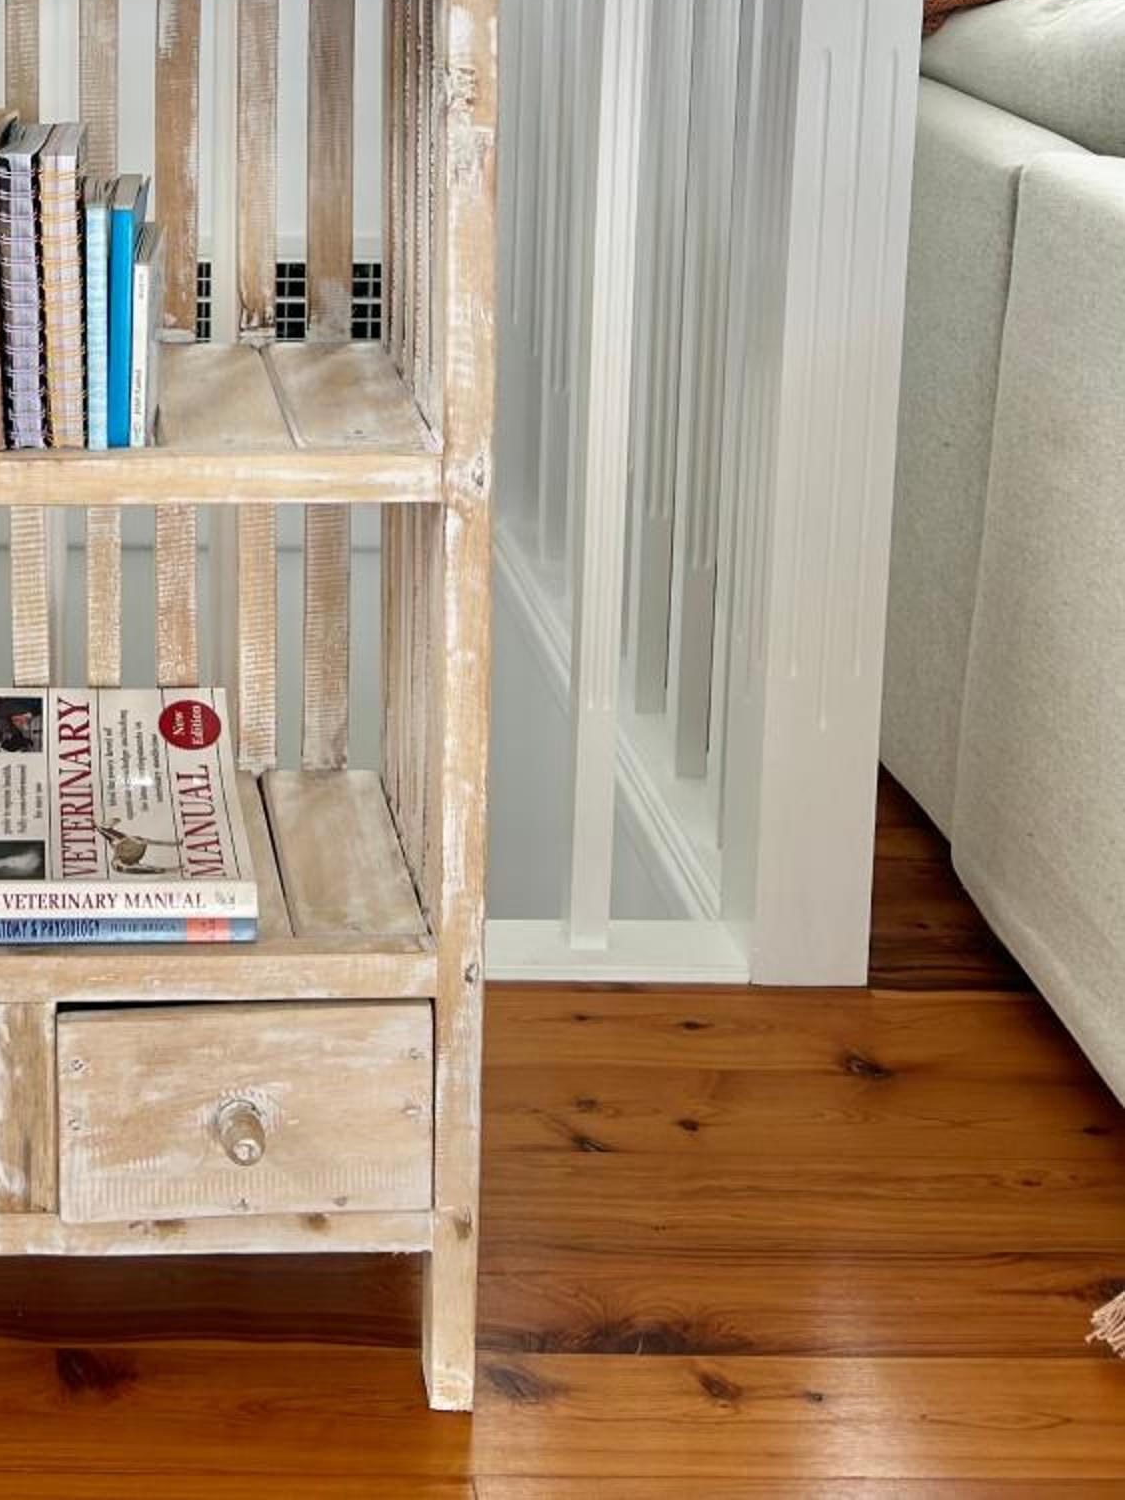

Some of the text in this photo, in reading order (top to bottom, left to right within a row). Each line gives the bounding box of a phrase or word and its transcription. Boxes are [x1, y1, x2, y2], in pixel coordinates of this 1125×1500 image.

[171, 710, 186, 736] New
[190, 705, 205, 745] Edition
[58, 696, 99, 879] VETERINARY
[176, 764, 227, 878] MANUAL
[2, 892, 118, 911] VETERINARY
[125, 891, 205, 910] MANUAL
[30, 920, 38, 936] &
[41, 920, 100, 938] PHYSIOLOGY
